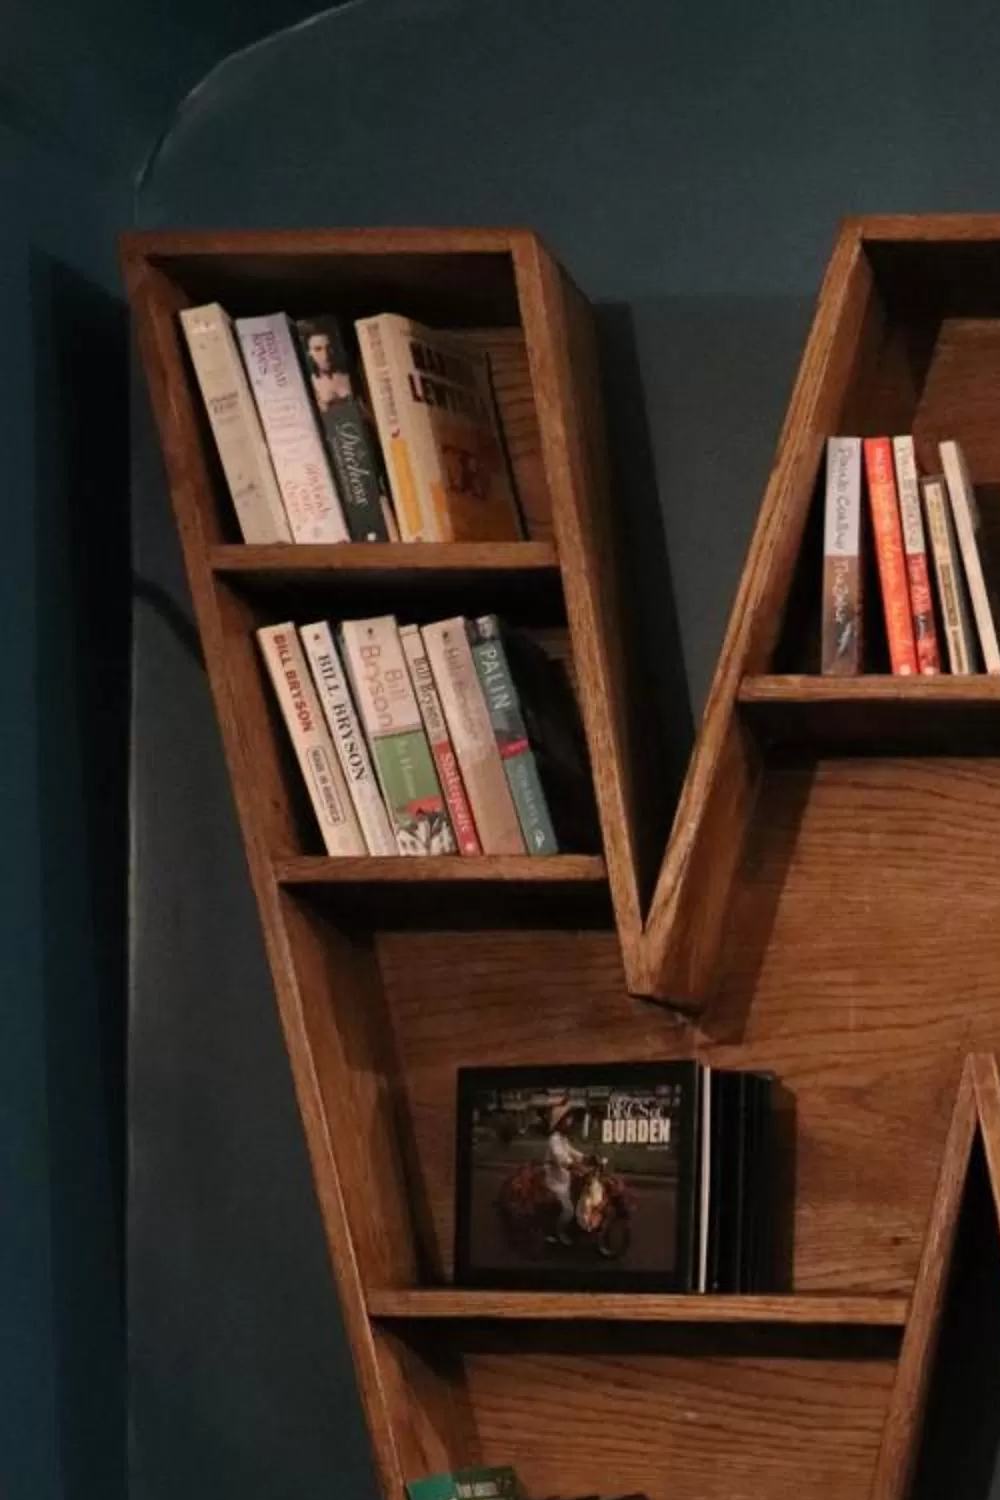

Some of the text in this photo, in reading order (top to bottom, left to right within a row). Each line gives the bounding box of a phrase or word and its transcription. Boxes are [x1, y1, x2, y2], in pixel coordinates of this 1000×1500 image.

[272, 633, 292, 666] BILL
[285, 669, 314, 733] BRYSON
[316, 652, 366, 782] BILL BRYSON
[358, 644, 395, 728] Bryson
[384, 667, 407, 701] Bill
[478, 647, 511, 711] PALIN
